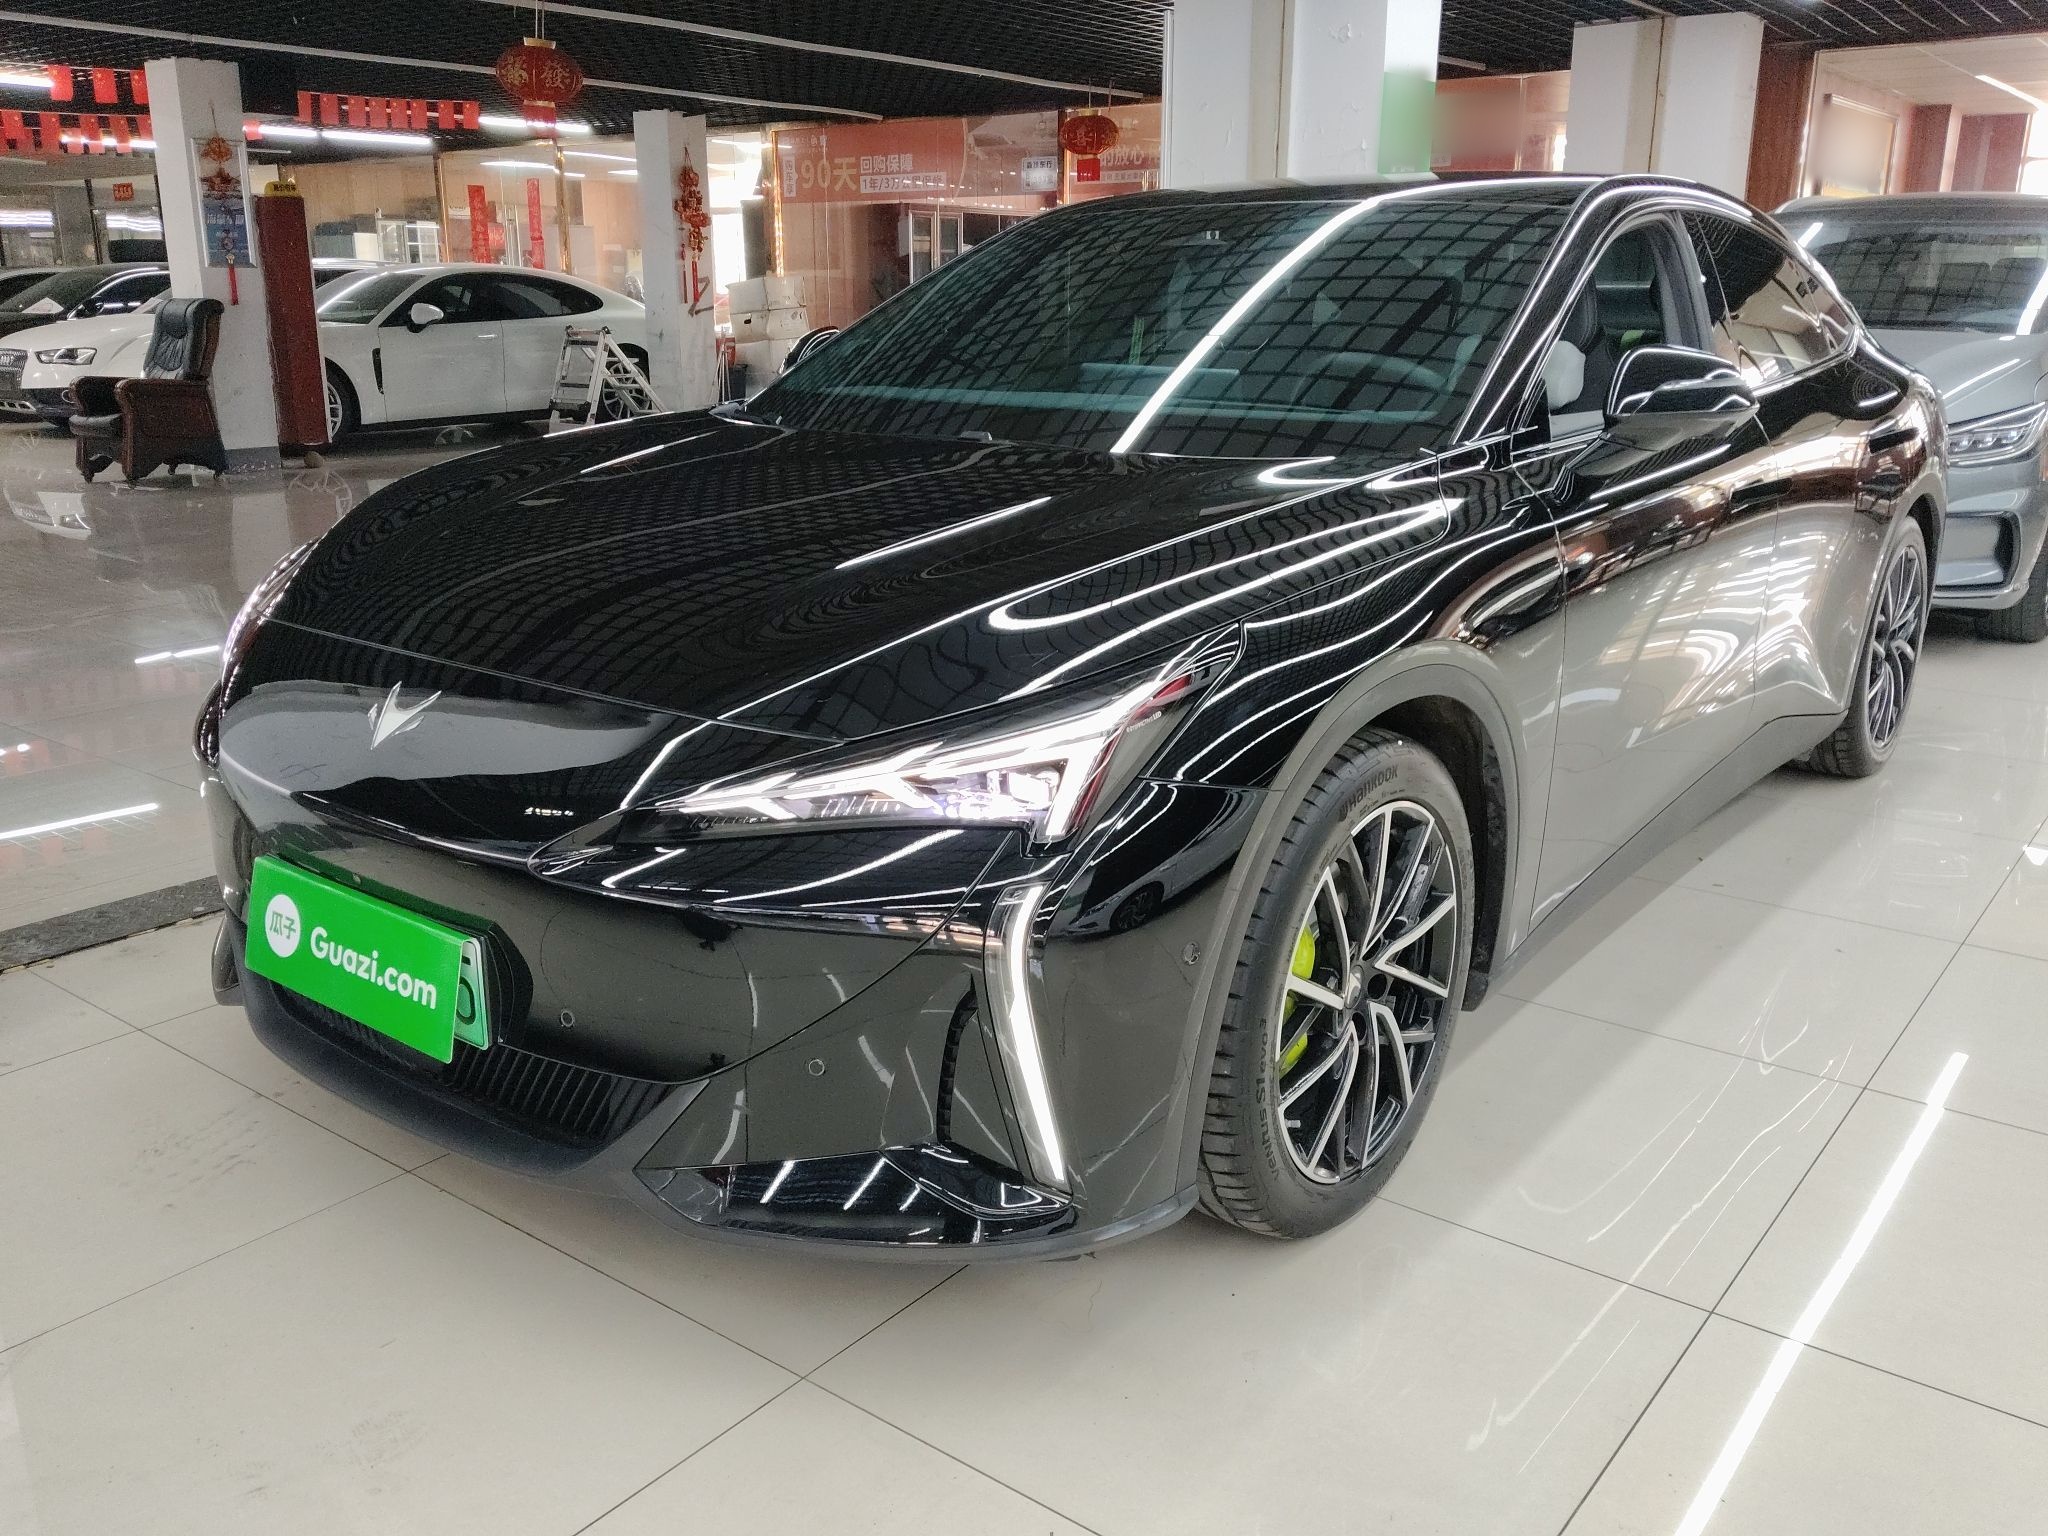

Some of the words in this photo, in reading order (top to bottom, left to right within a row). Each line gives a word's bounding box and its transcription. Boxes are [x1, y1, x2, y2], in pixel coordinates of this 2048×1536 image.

[801, 157, 857, 191] 90天
[860, 154, 913, 174] 回购保障
[269, 911, 296, 940] 瓜子
[310, 927, 437, 1009] Guazi.com
